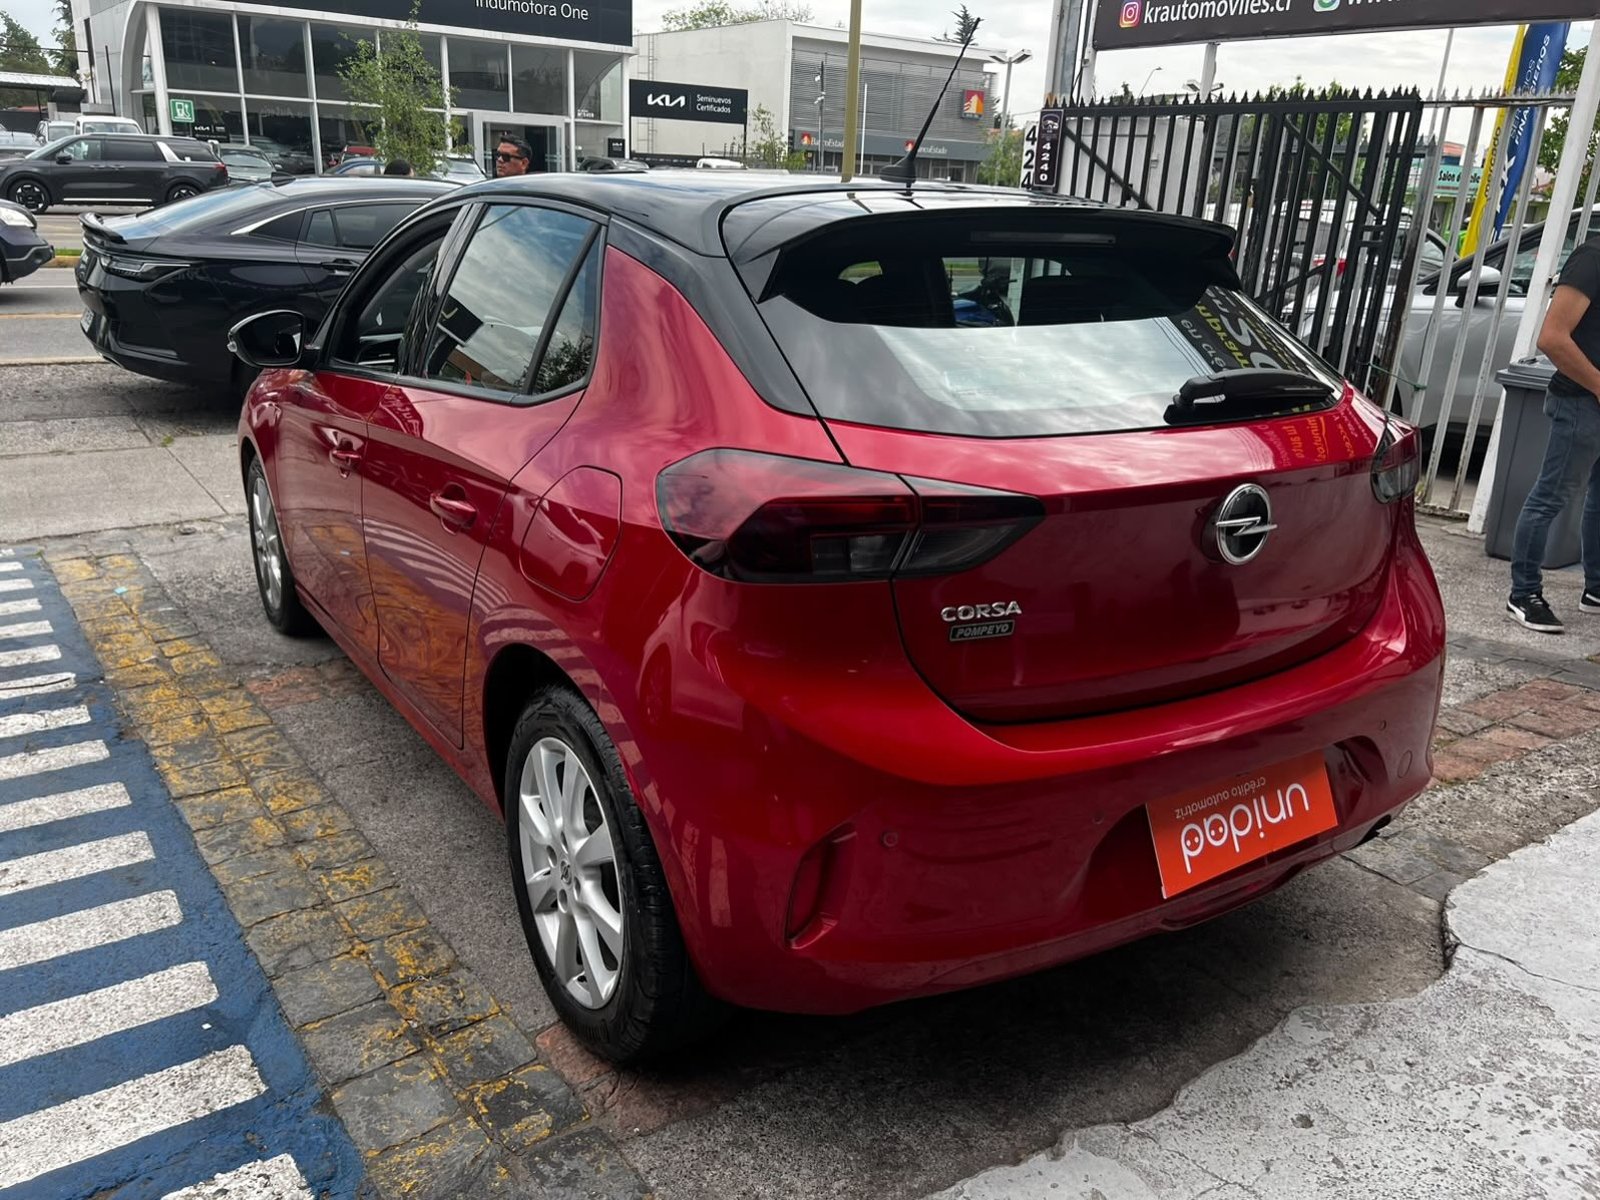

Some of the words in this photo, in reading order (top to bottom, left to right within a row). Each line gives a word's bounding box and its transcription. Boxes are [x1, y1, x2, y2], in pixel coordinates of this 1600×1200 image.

[560, 3, 589, 20] One
[1514, 34, 1550, 145] FINACIEROS
[696, 94, 732, 104] Seminuevos
[696, 103, 731, 113] Certificados
[811, 137, 845, 148] BacoEstad
[917, 144, 948, 155] ancoEstado
[941, 601, 1022, 622] CORSA
[955, 623, 1010, 639] POMPEYO
[1231, 776, 1266, 797] crédito
[1175, 790, 1230, 820] automotriz
[1180, 783, 1310, 874] unidad
